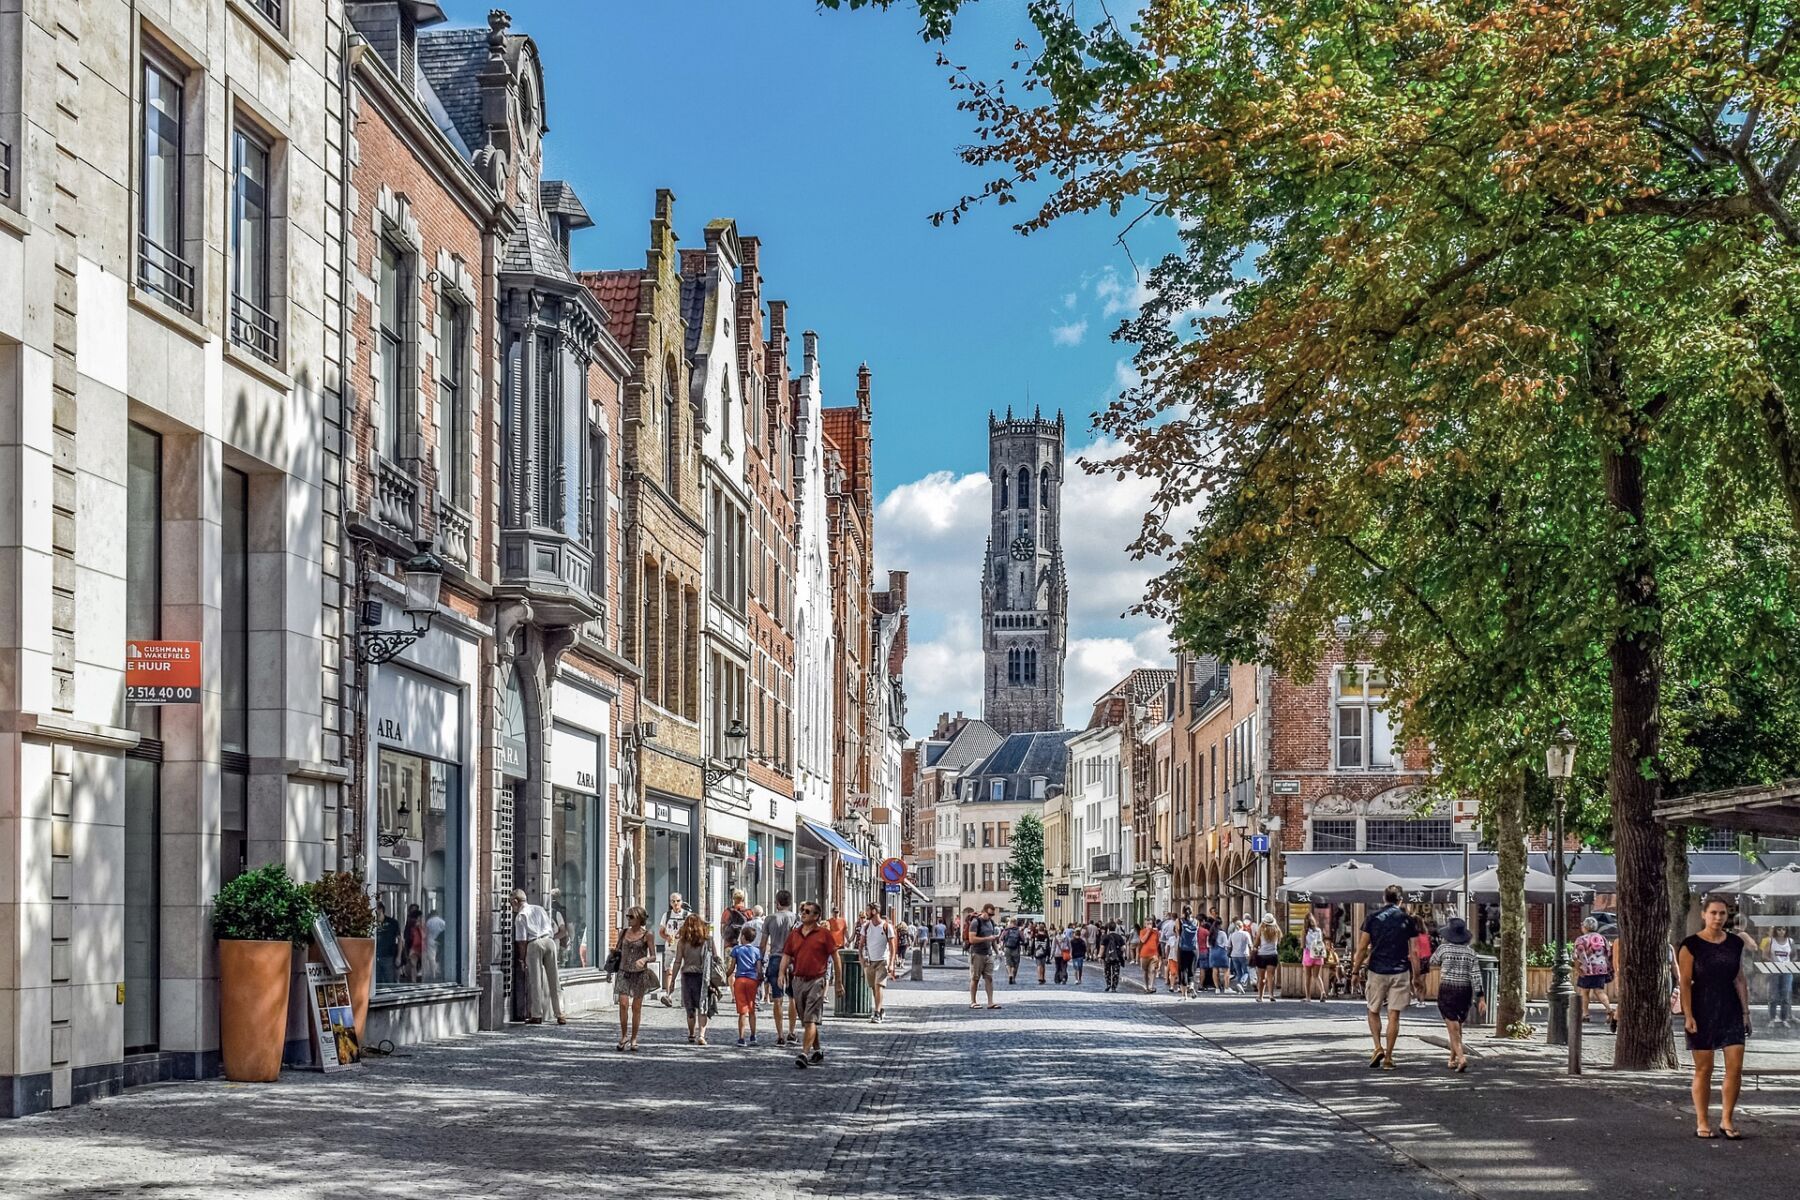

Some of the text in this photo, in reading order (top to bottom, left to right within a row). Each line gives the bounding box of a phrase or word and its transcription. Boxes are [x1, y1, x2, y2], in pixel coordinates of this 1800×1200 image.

[138, 661, 171, 671] HUUR
[137, 687, 156, 698] 514
[158, 687, 174, 698] 40
[177, 687, 192, 699] 00
[577, 771, 595, 789] ZARA
